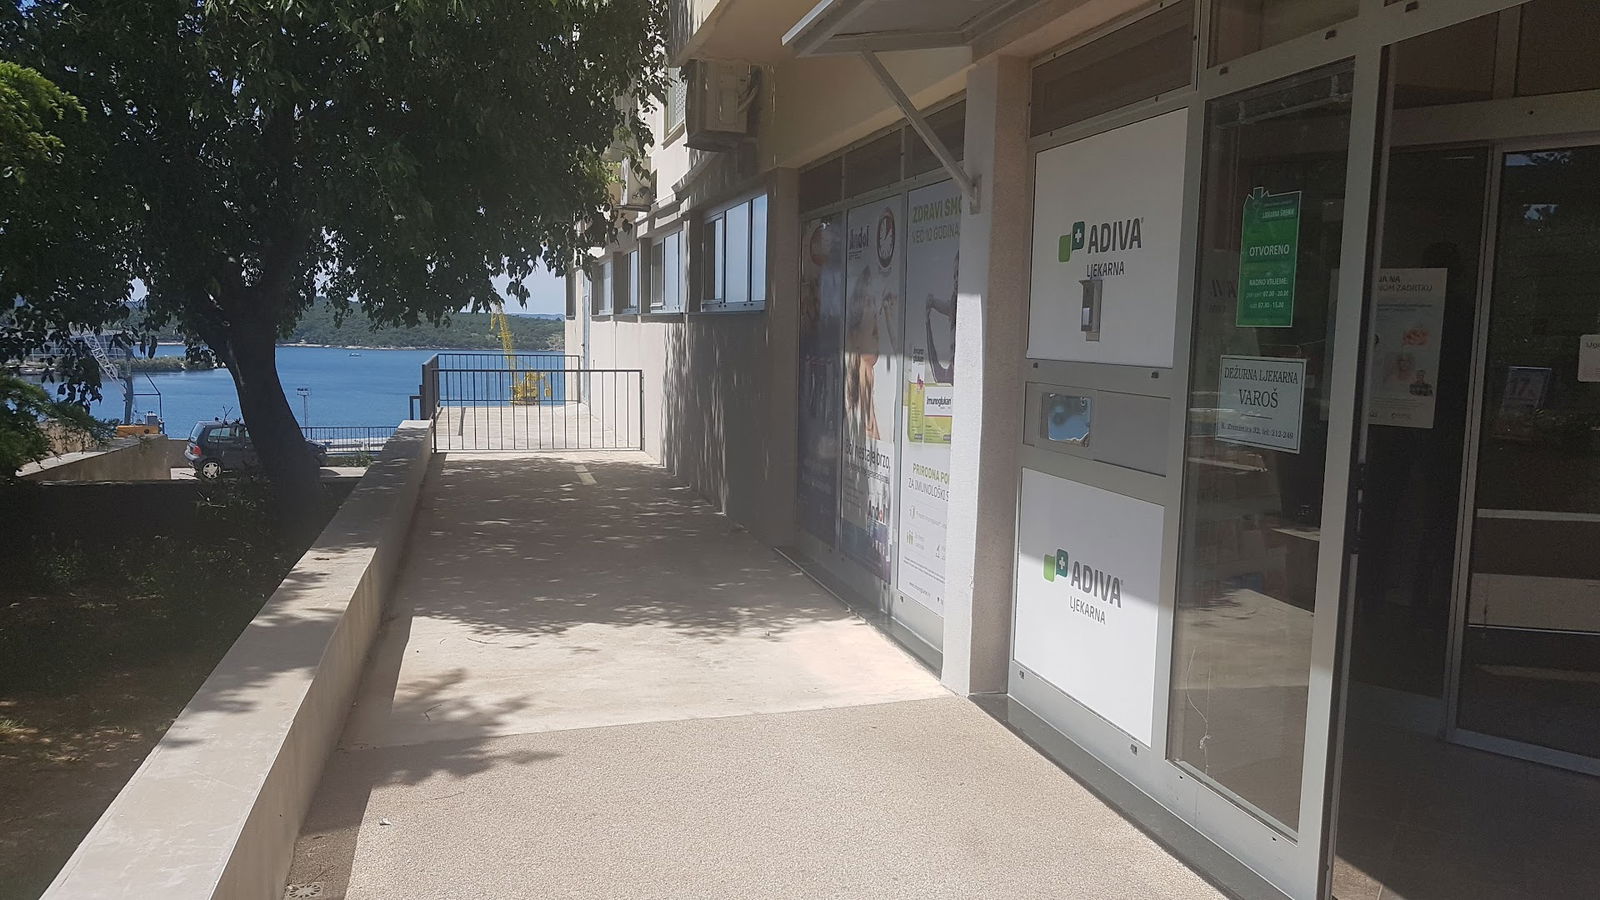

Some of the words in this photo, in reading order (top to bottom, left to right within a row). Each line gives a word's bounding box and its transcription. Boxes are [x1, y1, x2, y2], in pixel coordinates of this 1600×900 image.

[912, 200, 943, 223] ZDRAVI
[1087, 217, 1142, 254] ADIVA
[1249, 244, 1290, 257] OTVORENO
[1086, 261, 1125, 280] LJEKARNA
[1224, 365, 1258, 381] DEŽURNA
[1259, 370, 1298, 385] LJEKARNA
[1239, 386, 1279, 409] VAROŠ
[912, 463, 939, 482] PRIRODNA
[908, 477, 915, 490] ZA
[915, 479, 946, 501] IMUNOLOŠKI
[1070, 560, 1121, 609] ADIVA
[1069, 595, 1106, 625] LJEKARNA
